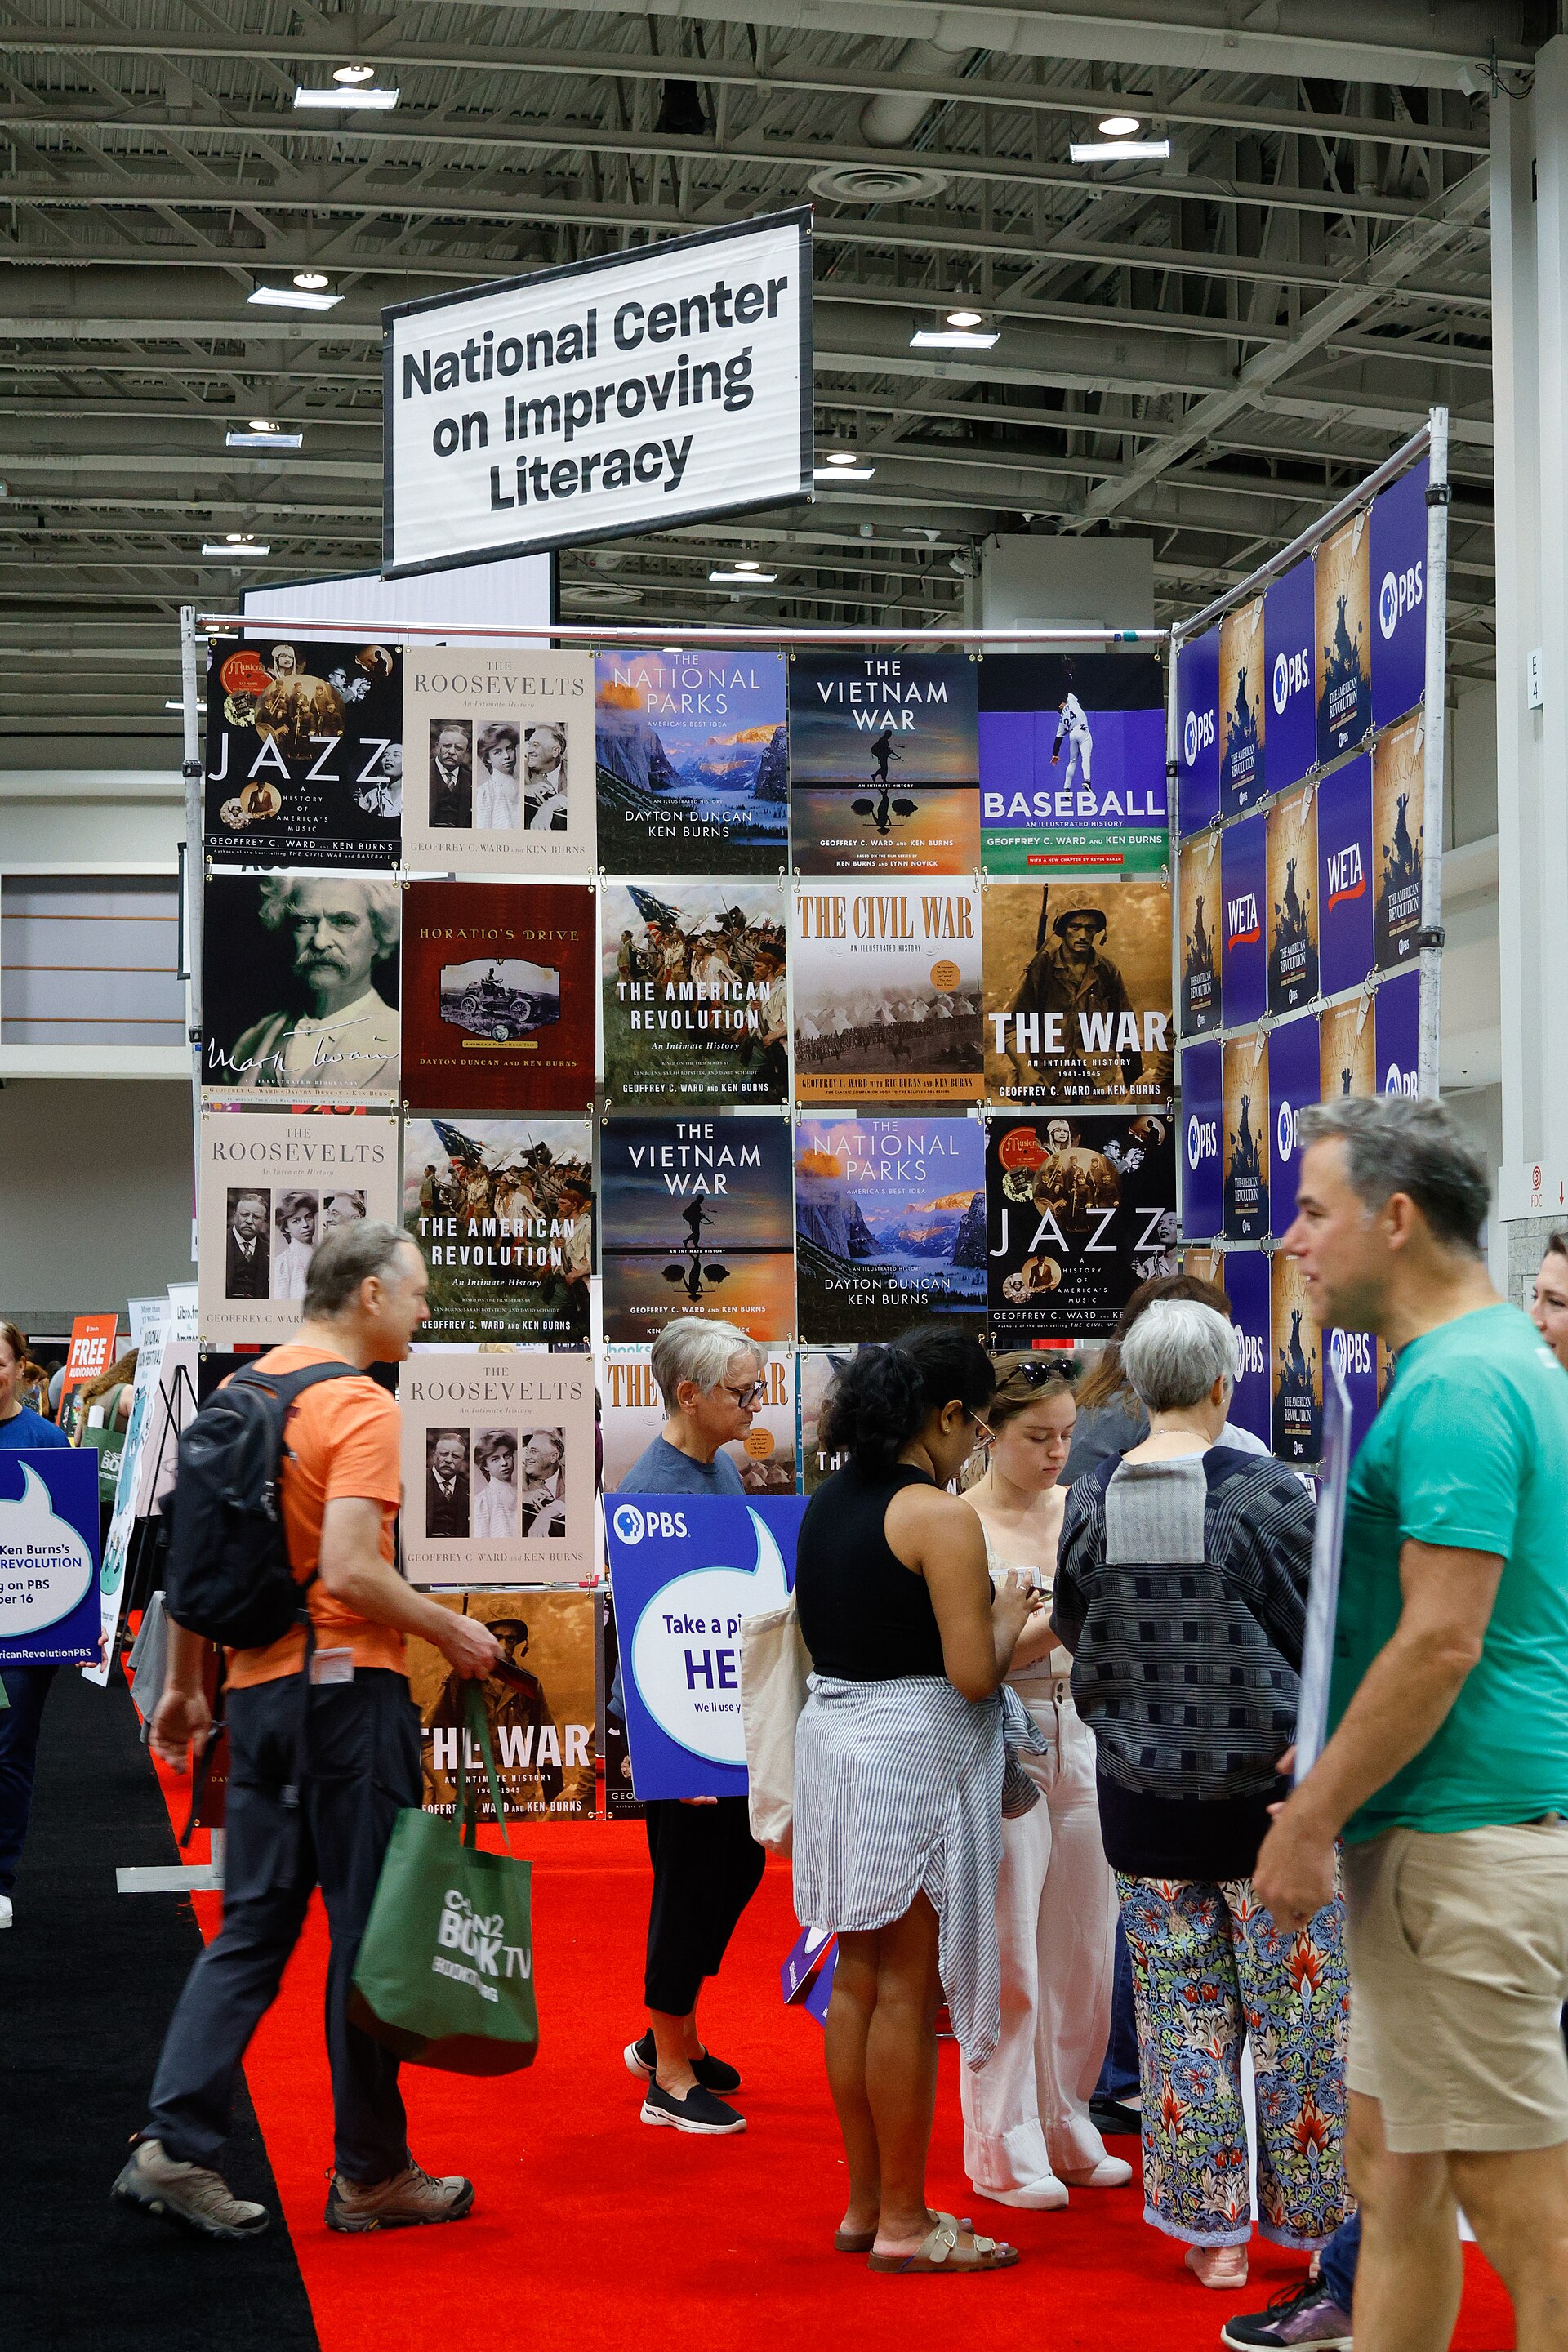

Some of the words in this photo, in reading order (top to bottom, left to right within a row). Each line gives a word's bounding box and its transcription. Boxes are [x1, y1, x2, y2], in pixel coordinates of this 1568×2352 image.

[402, 308, 598, 400] National
[613, 275, 789, 351] Center
[432, 408, 488, 457] on
[505, 345, 755, 443] Improving
[490, 434, 694, 513] Literacy
[1398, 560, 1423, 618] PBS
[486, 661, 512, 670] THE
[673, 654, 699, 666] THE
[864, 660, 902, 676] THE
[1532, 655, 1537, 675] E
[614, 668, 760, 689] NATIONAL
[1289, 648, 1308, 697] PBS
[413, 674, 584, 697] ROOSEVELTS
[817, 681, 948, 704] VIETNAM
[1329, 688, 1338, 705] THE
[1338, 675, 1357, 700] AMERICAN
[1533, 680, 1538, 700] 4
[647, 693, 728, 714] PARKS
[1329, 688, 1357, 719] REVOLUTION
[852, 708, 915, 731] WAR
[1197, 708, 1214, 751] PBS
[207, 732, 391, 783] JAZZ
[983, 791, 1165, 817] BASEBALL
[276, 815, 328, 823] AMERICA'S
[625, 811, 683, 822] DAYTON
[690, 811, 751, 822] DUNCAN
[648, 826, 675, 837] KEN
[683, 826, 729, 838] BURNS
[987, 837, 1040, 846] GEOFFREY
[1043, 837, 1053, 845] C.
[1056, 836, 1087, 845] WARD
[1106, 836, 1126, 844] KEN
[1129, 835, 1163, 844] BURNS
[209, 837, 264, 847] GEOFFREY
[269, 840, 280, 848] C.
[286, 840, 316, 849] WARD
[332, 842, 353, 850] KEN
[359, 842, 393, 851] BURNS
[1327, 842, 1363, 895] WETA
[1388, 892, 1397, 907] THE
[1397, 882, 1419, 903] AMERICAN
[796, 896, 846, 938] THE
[853, 896, 914, 938] CIVIL
[920, 896, 975, 938] WAR
[1227, 893, 1258, 937] WETA
[1388, 896, 1419, 923] REVOLUTION
[419, 928, 514, 941] HORATIO'S
[522, 930, 579, 941] DRIVE
[860, 945, 896, 953] ILLUSTRATED
[898, 944, 921, 952] HISTORY
[617, 982, 655, 1001] THE
[665, 982, 771, 1001] AMERICAN
[630, 1009, 759, 1029] REVOLUTION
[988, 1012, 1065, 1054] THE
[1078, 1011, 1169, 1053] WAR
[706, 1042, 740, 1050] History
[1027, 1059, 1038, 1067] AN
[1092, 1058, 1131, 1067] HISTORY
[622, 1084, 666, 1093] GEOFFREY
[669, 1084, 677, 1093] C.
[680, 1084, 704, 1092] WARD
[721, 1084, 738, 1092] KEN
[742, 1083, 769, 1092] BURNS
[802, 1078, 837, 1089] GEOFFREY
[840, 1079, 846, 1088] C.
[849, 1078, 867, 1088] WARD
[870, 1080, 884, 1088] WITH
[898, 1078, 921, 1088] BURNS
[924, 1080, 933, 1088] AND
[934, 1078, 948, 1087] KEN
[950, 1078, 973, 1088] BURNS
[1403, 1071, 1419, 1102] PB
[285, 1128, 311, 1138] THE
[676, 1123, 714, 1139] THE
[873, 1121, 898, 1132] THE
[813, 1135, 960, 1156] NATIONAL
[1200, 1120, 1218, 1159] PBS
[211, 1142, 385, 1164] ROOSEVELTS
[627, 1144, 761, 1168] VIETNAM
[846, 1160, 927, 1181] PARKS
[663, 1172, 728, 1196] WAR
[1530, 1193, 1543, 1208] FDC
[418, 1217, 457, 1237] THE
[467, 1218, 575, 1238] AMERICAN
[989, 1207, 1166, 1257] JAZZ
[431, 1245, 563, 1266] REVOLUTION
[71, 1338, 107, 1366] FREE
[1245, 1335, 1263, 1373] PBS
[1347, 1332, 1370, 1374] PBS
[69, 1366, 102, 1378] AUDIOBOOK
[483, 1366, 510, 1377] THE
[410, 1382, 583, 1401] ROOSEVELTS
[608, 1364, 658, 1408] THE
[758, 1362, 789, 1406] AR
[1284, 1396, 1292, 1407] THE
[1292, 1396, 1312, 1407] AMERICAN
[1284, 1409, 1312, 1422] REVOLUTION
[648, 1512, 688, 1538] PBS
[0, 1545, 23, 1555] Ken
[26, 1544, 70, 1554] Burns's
[0, 1557, 82, 1569] REVOLUTION
[7, 1582, 24, 1590] on
[28, 1579, 50, 1589] PBS
[21, 1594, 33, 1603] 16
[662, 1613, 706, 1634] Take
[711, 1619, 721, 1633] a
[0, 1648, 91, 1659] ricanRevolutionPBS
[684, 1649, 742, 1689] HE
[694, 1702, 717, 1712] We'll
[421, 1727, 483, 1770] HE
[497, 1725, 590, 1768] WAR
[501, 1945, 531, 1980] TV
